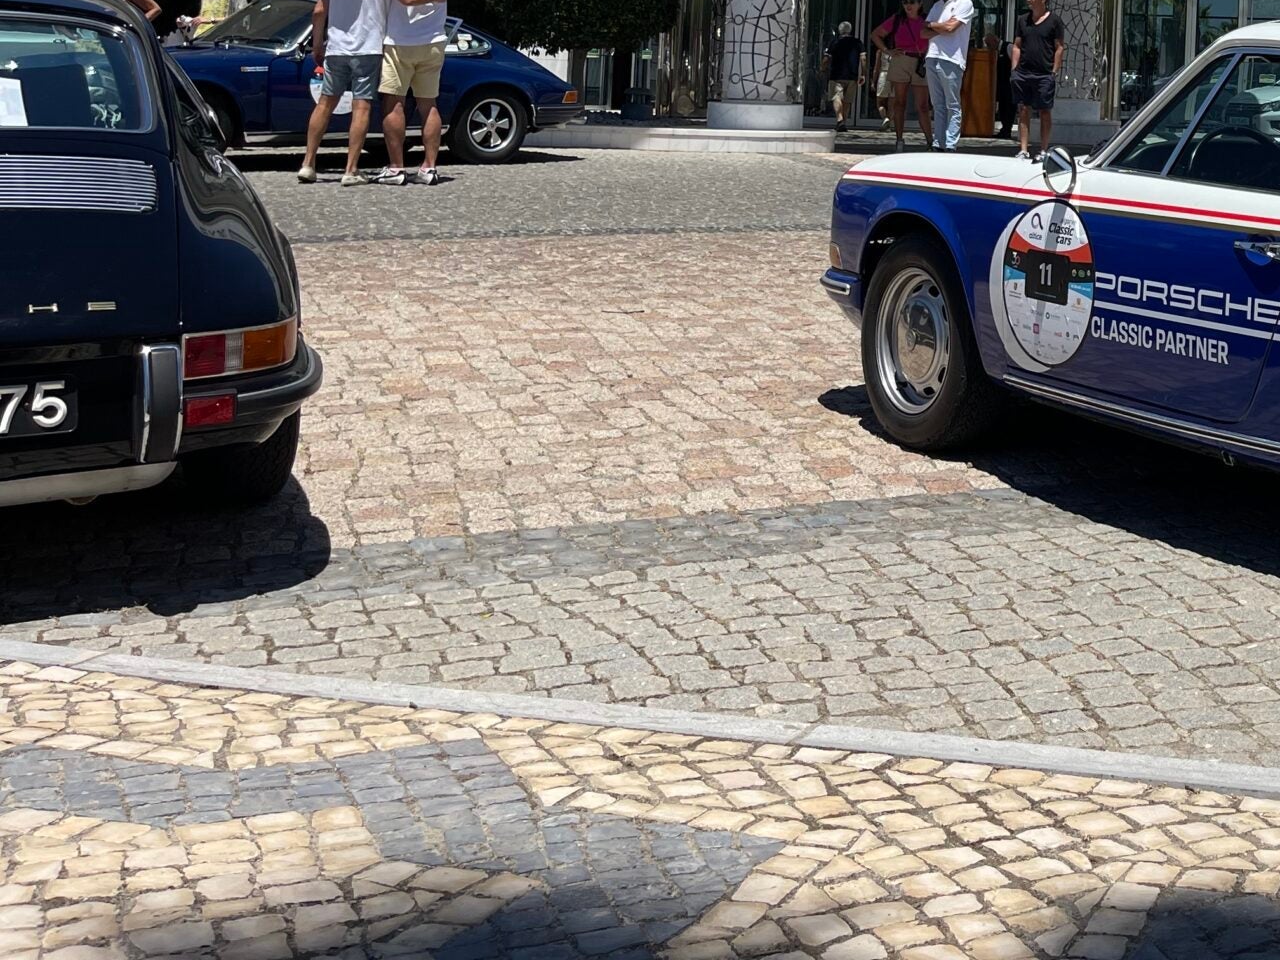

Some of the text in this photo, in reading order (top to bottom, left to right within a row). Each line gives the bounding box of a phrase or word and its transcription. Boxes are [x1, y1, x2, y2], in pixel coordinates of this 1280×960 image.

[1048, 222, 1075, 237] Classic
[1055, 235, 1073, 246] cars
[1039, 262, 1053, 286] 11
[1091, 316, 1153, 351] CLASSIC
[1156, 329, 1231, 366] PARTNER
